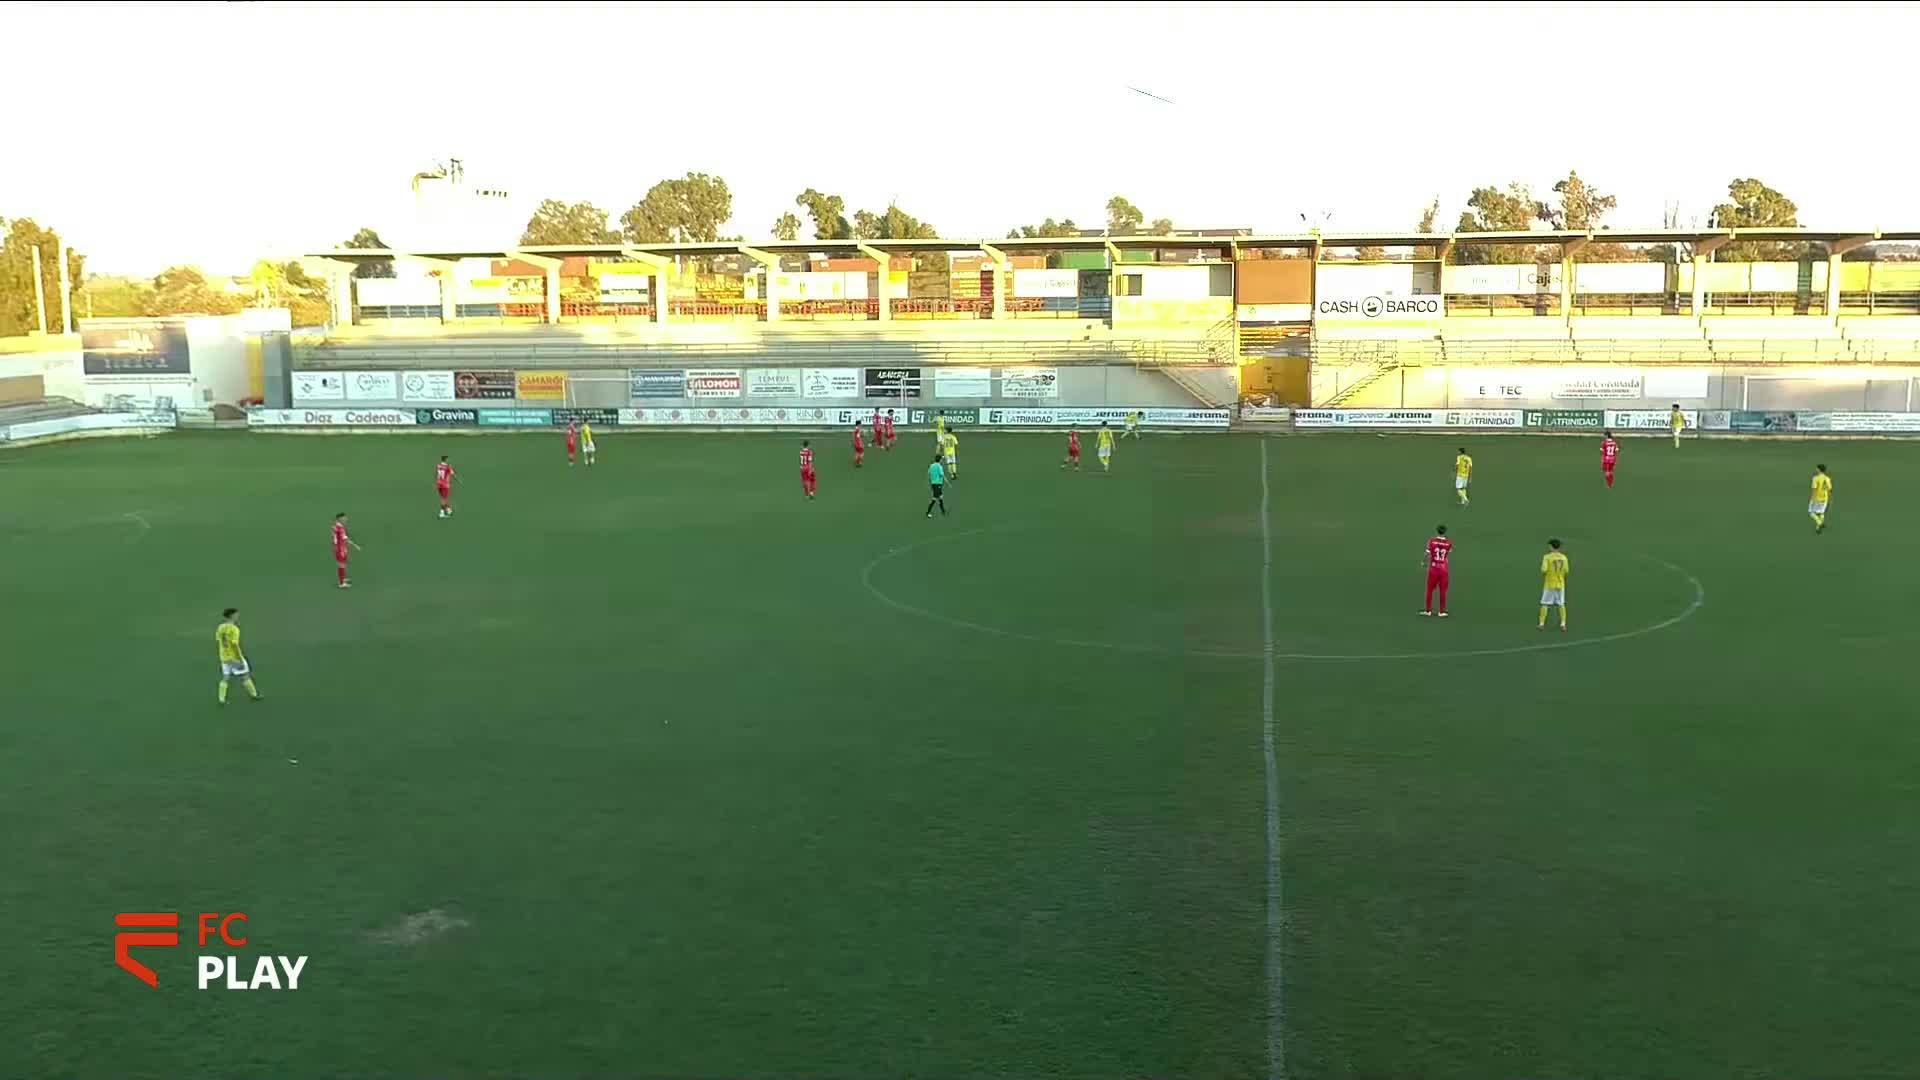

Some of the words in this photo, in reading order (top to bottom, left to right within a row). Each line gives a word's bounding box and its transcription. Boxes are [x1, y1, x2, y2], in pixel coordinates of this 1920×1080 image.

[1320, 300, 1358, 313] CASH
[1386, 300, 1438, 313] BARCO
[1500, 386, 1522, 395] TEC
[345, 411, 401, 423] Cadenas
[432, 410, 474, 421] Gravina
[1434, 547, 1447, 561] 33
